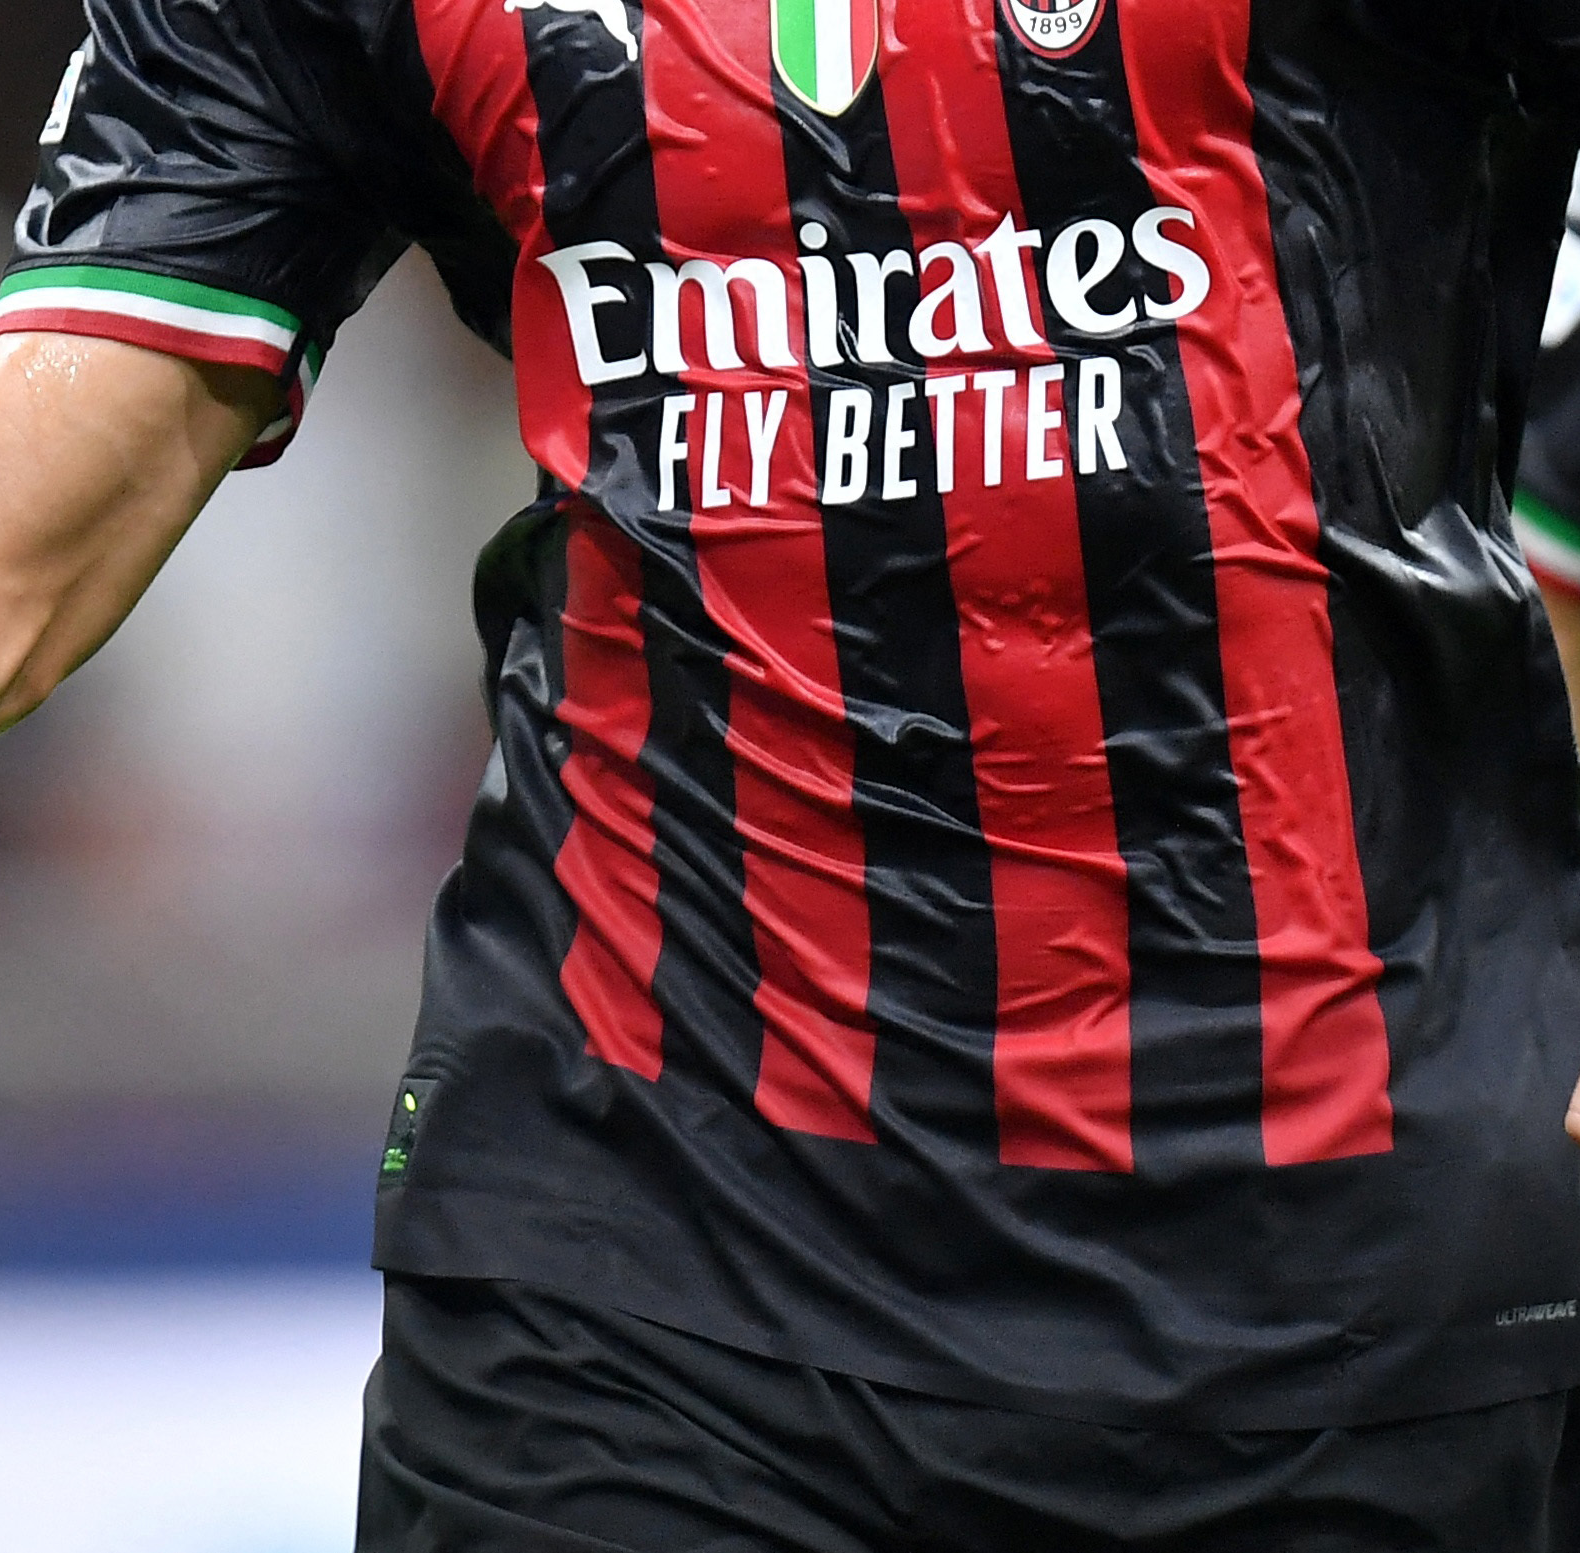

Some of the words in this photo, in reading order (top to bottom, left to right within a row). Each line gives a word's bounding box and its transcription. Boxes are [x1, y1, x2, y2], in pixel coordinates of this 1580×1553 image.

[1029, 11, 1083, 35] 1899
[536, 206, 1211, 386] Emirates
[657, 390, 787, 511] FLY
[821, 356, 1127, 505] BETTER
